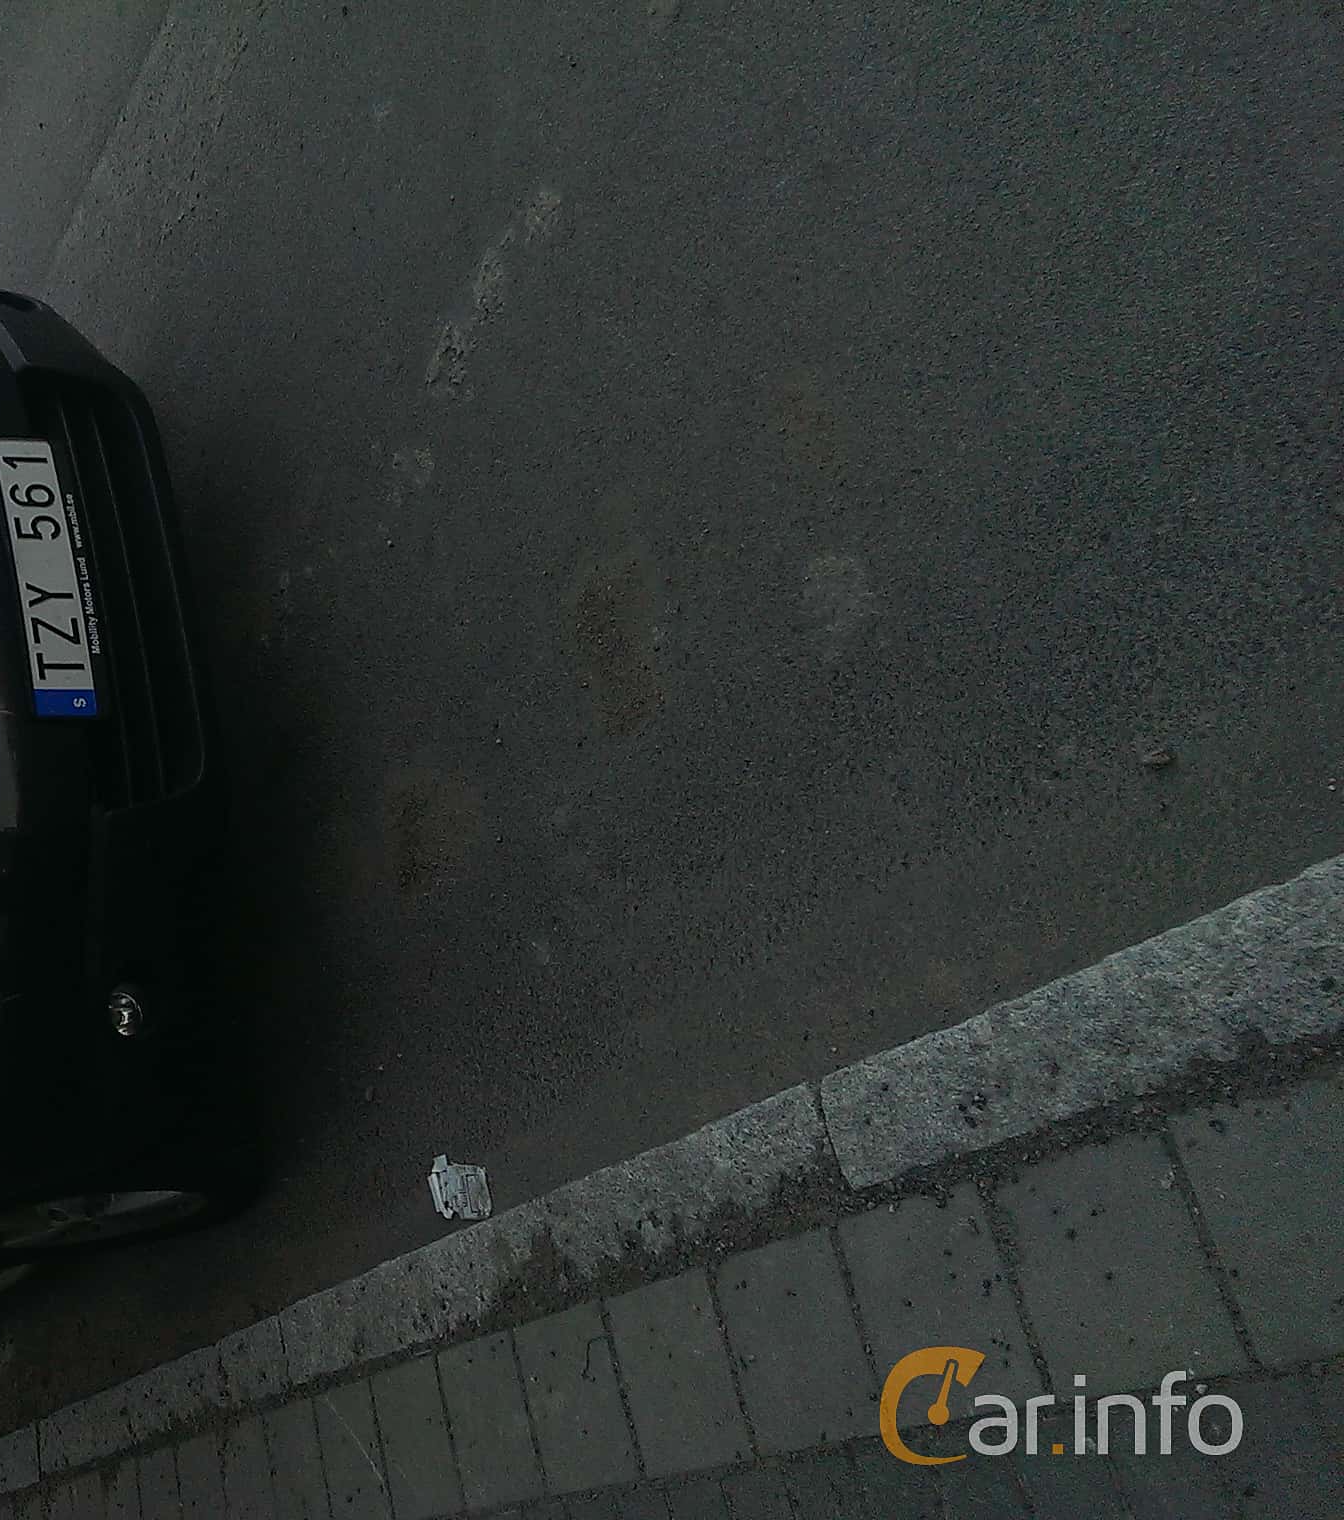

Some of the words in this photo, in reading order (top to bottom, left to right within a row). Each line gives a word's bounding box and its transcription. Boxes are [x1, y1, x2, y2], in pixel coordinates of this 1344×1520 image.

[2, 456, 61, 540] 561
[77, 557, 89, 580] Lund
[83, 582, 95, 615] Motors
[25, 582, 85, 680] TZY
[88, 616, 100, 654] Mobility
[73, 697, 87, 708] S
